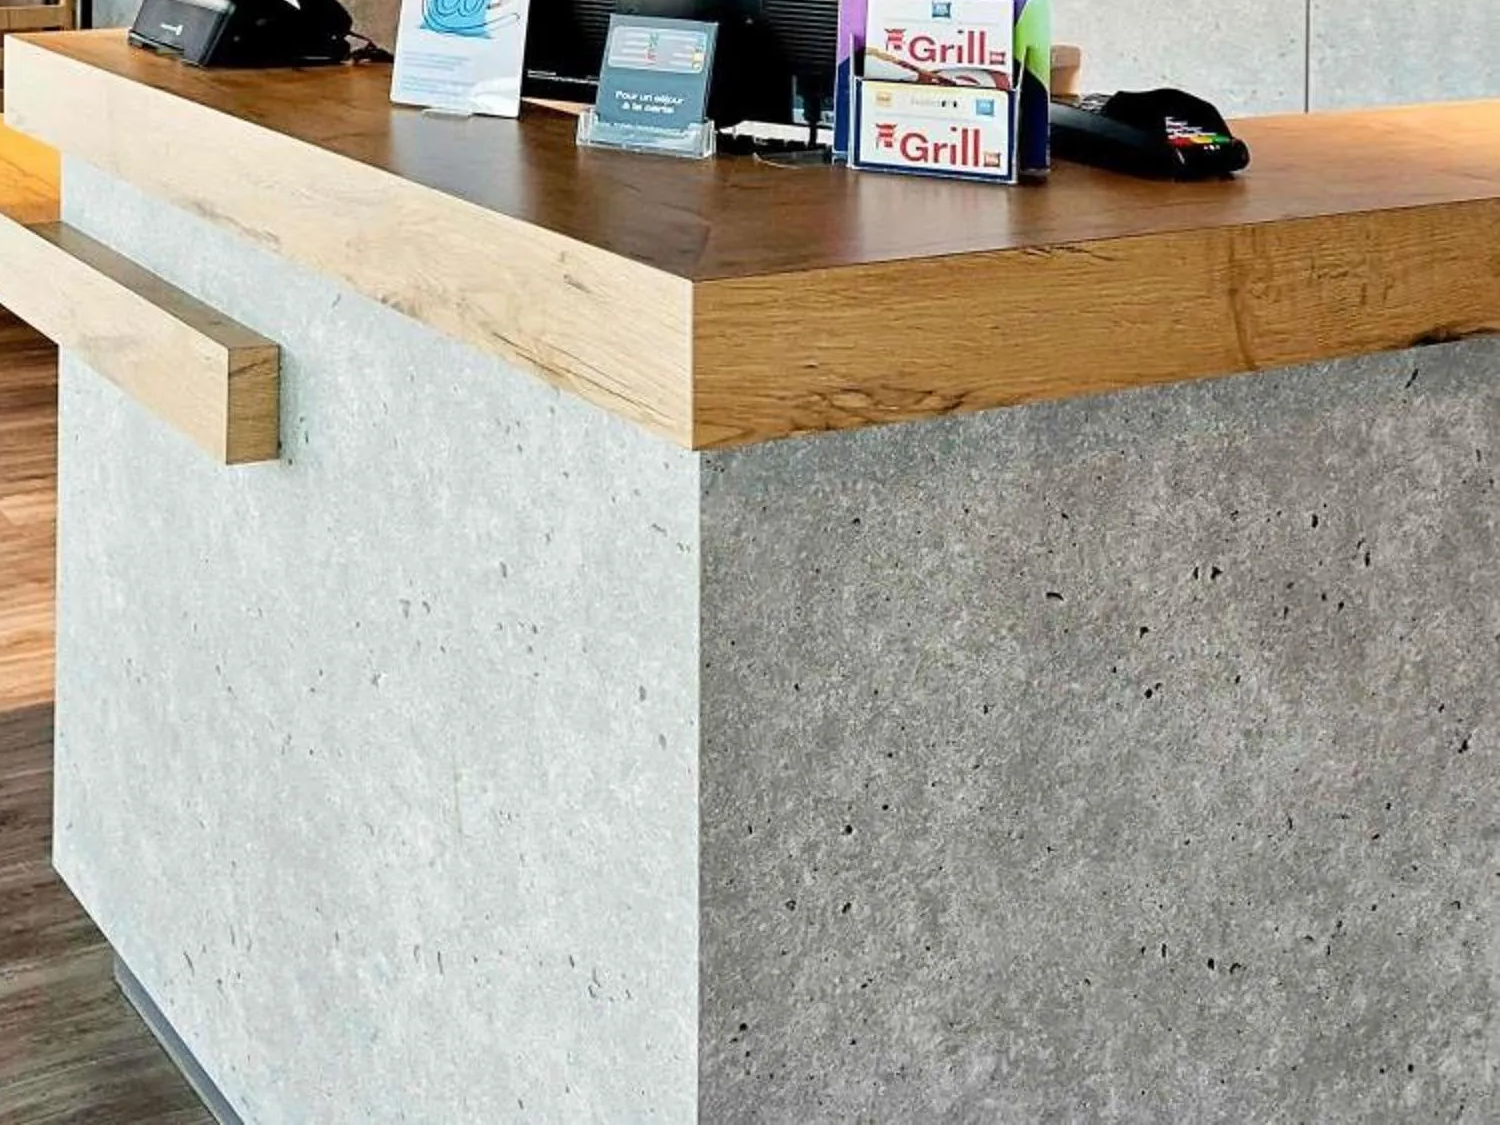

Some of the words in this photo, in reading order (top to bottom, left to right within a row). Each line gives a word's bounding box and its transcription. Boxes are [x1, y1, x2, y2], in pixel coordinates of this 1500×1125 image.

[908, 29, 986, 65] Grill
[615, 90, 638, 100] Pour
[640, 93, 653, 102] un
[899, 126, 980, 168] Grill
